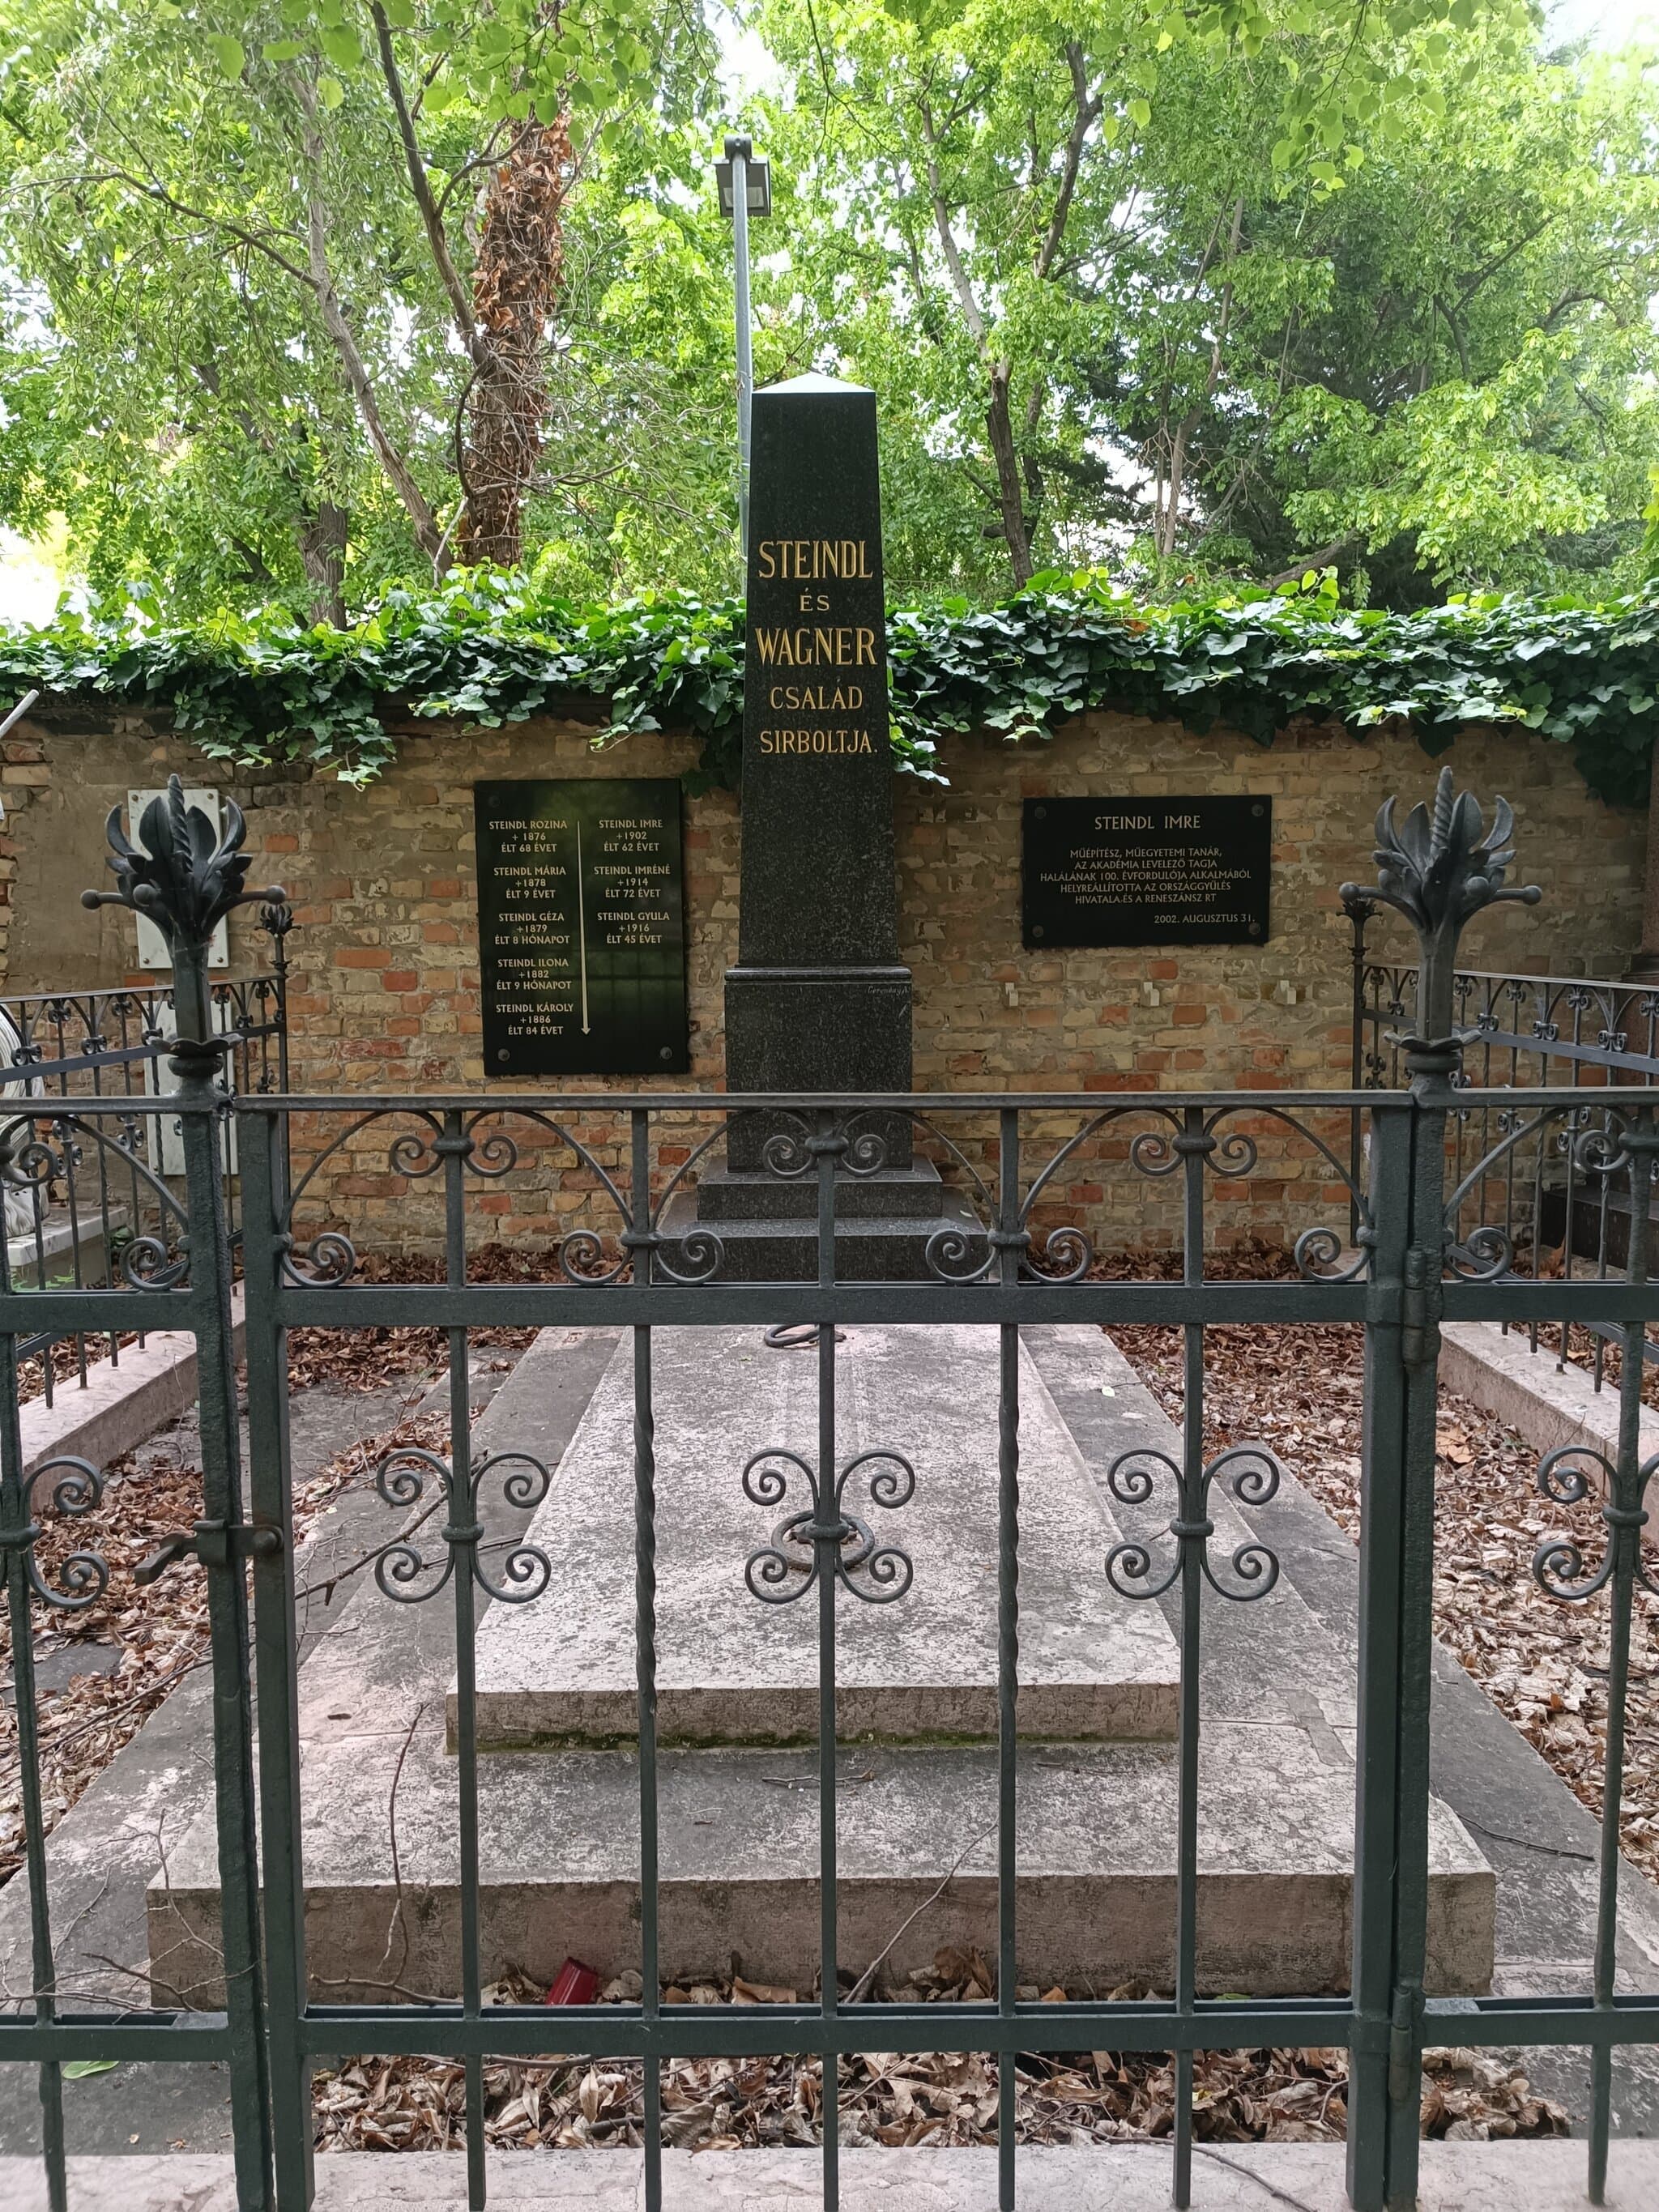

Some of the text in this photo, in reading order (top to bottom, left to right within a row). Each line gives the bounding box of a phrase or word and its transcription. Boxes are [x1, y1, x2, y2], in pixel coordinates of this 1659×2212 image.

[758, 539, 873, 579] STEINDL
[799, 587, 830, 612] ÉS
[754, 627, 877, 666] WAGNER
[770, 677, 863, 710] CSALÁD
[488, 820, 568, 829] STEINDL ROZINA
[599, 820, 663, 829] STEINDL IMRE
[1094, 815, 1201, 830] STEINDL IMRE
[501, 842, 557, 853] ÉLT 68 ÉVET
[603, 842, 660, 851] ÉLT 62 ÉVET
[1188, 846, 1222, 857] TANÁR,
[594, 864, 671, 875] STEINDL IMRÉNÉ
[1074, 860, 1087, 870] AZ
[1090, 859, 1140, 870] AKADÉMIA
[1188, 859, 1218, 869] TAGJA
[493, 865, 566, 876] STEINDL MÁRIA
[1040, 867, 1252, 882] HALÁLÁNAK 100. ÉVFORDULÓJA ALKALMÁBÓL
[1060, 880, 1141, 893] HELYREÁLLÍTOTTA
[1144, 883, 1158, 892] AZ
[505, 888, 556, 899] ÉLT 9 ÉVET
[605, 888, 661, 898] ÉLT 72 ÉVET
[1123, 892, 1133, 903] ÉS
[1135, 893, 1142, 903] A
[1145, 892, 1203, 903] RENESZÁNSZ
[1205, 893, 1217, 902] RT
[498, 911, 565, 922] STEINDL GÉZA
[597, 912, 670, 921] STEINDL GYULA
[1154, 914, 1256, 923] 2002. AUGUSZTUS 31.
[494, 934, 569, 944] ÉLT 8 HÓNAPOT
[606, 934, 662, 944] ÉLT 45 ÉVET
[497, 958, 569, 967] STEINDL ILONA
[497, 979, 572, 990] ÉLT 9 HÓNAPOT
[496, 1002, 574, 1012] STEINDL KÁROLY
[508, 1025, 564, 1035] ÉLT 84 ÉVET
